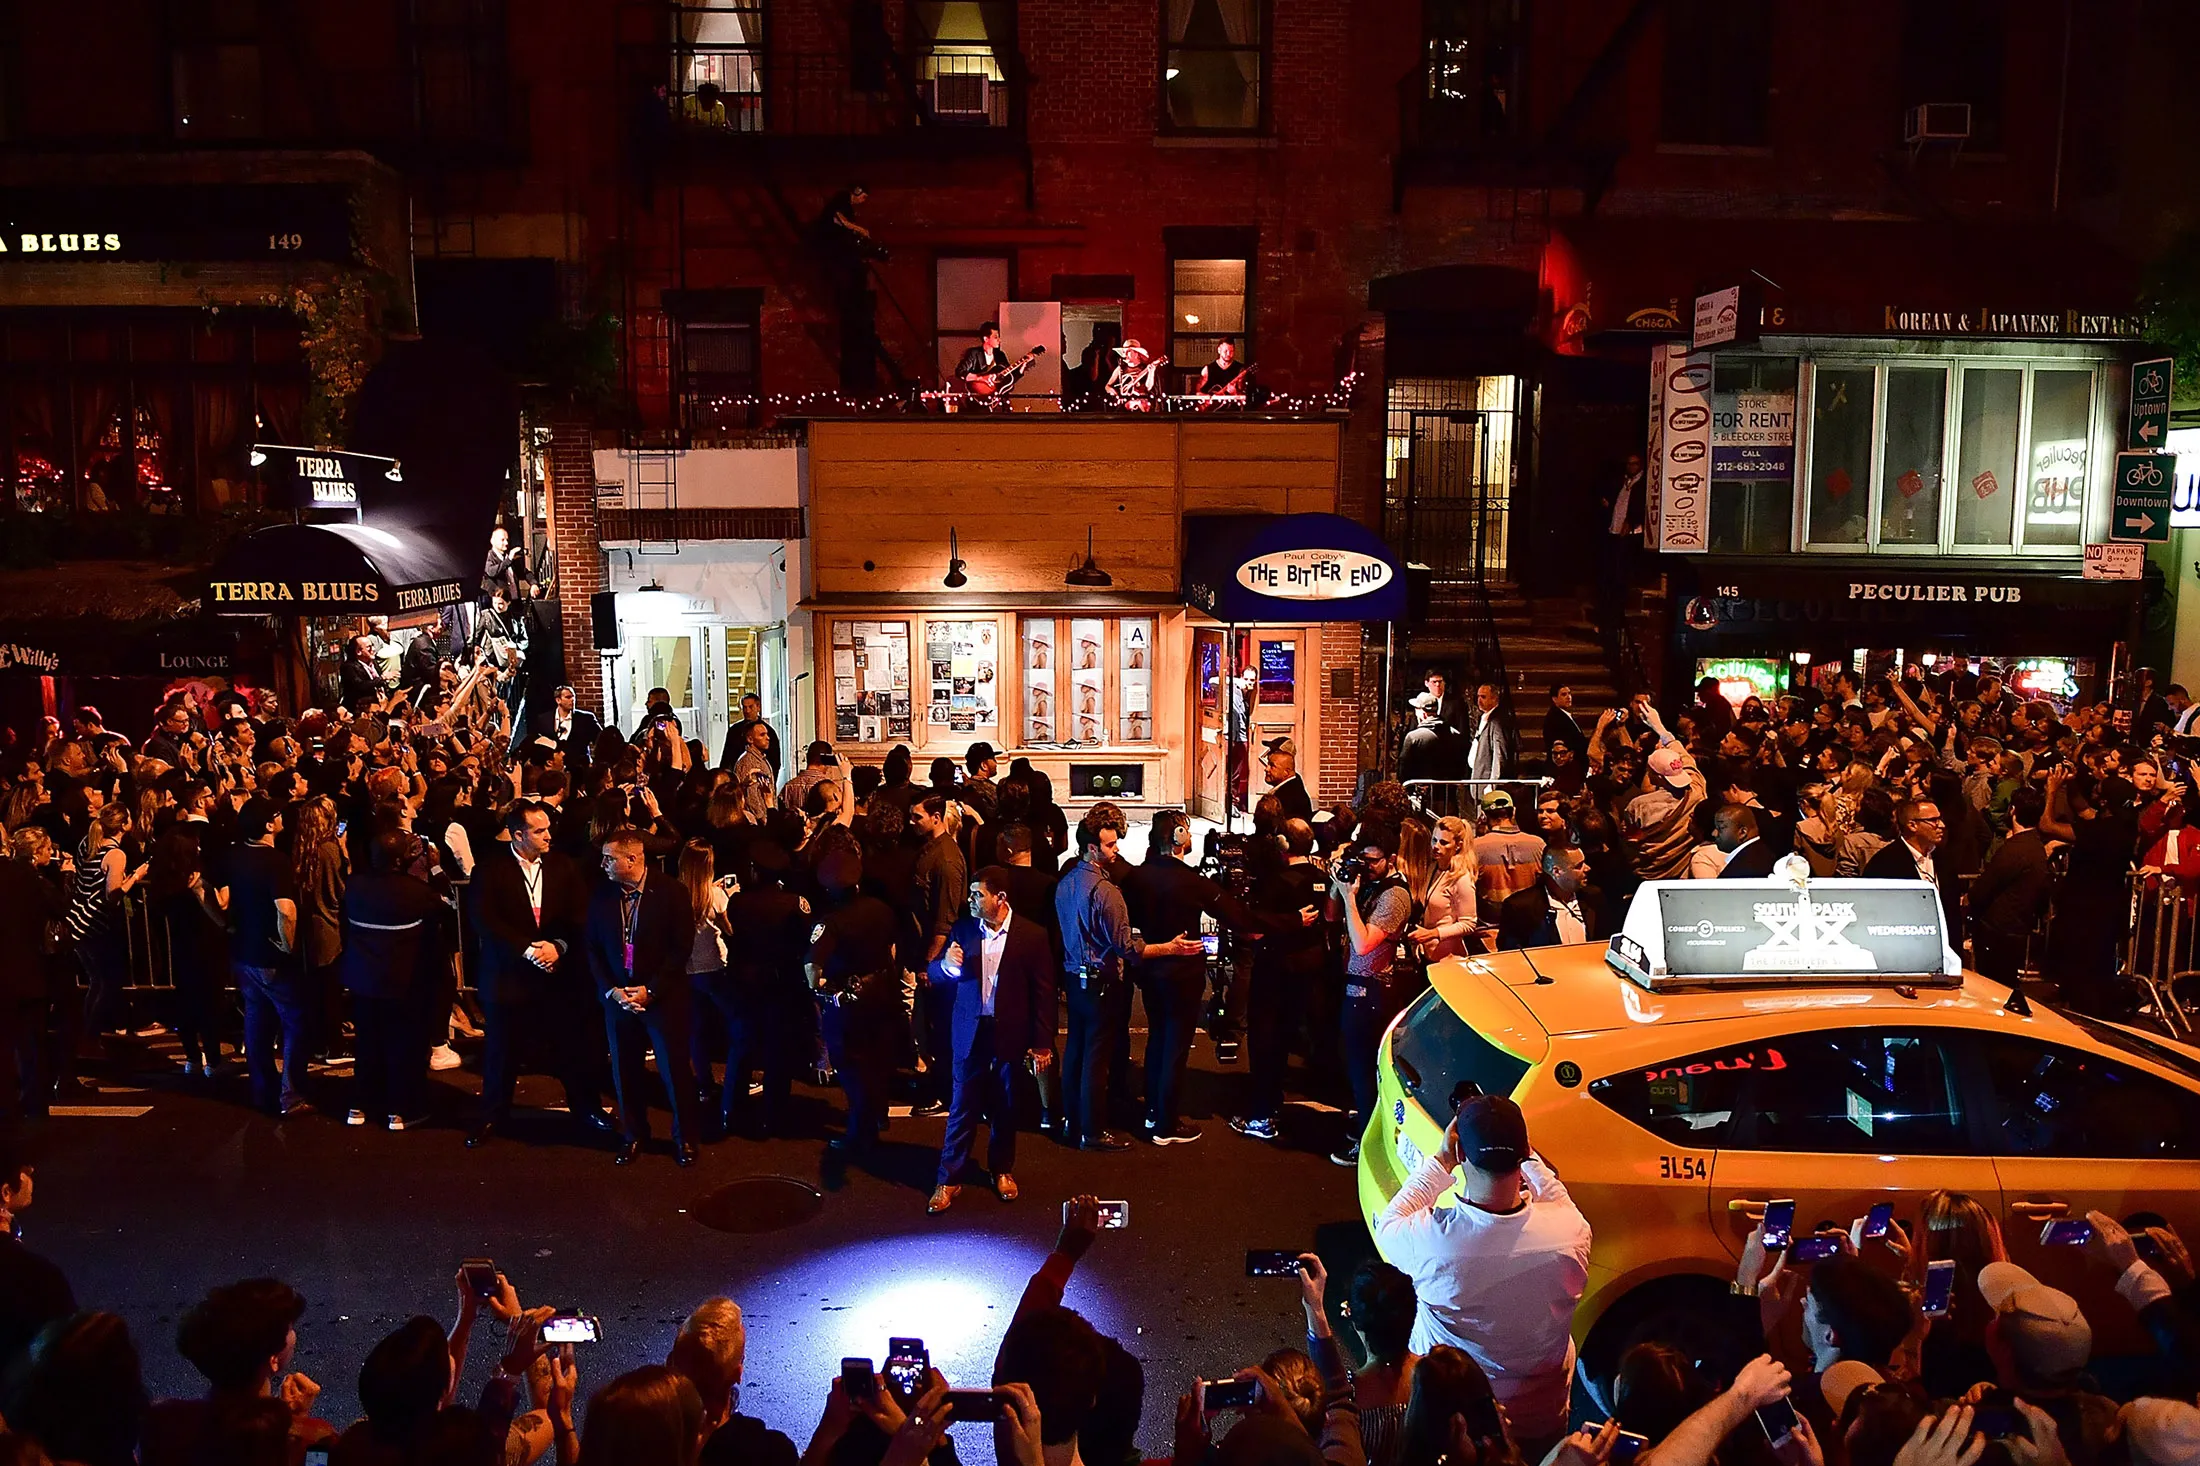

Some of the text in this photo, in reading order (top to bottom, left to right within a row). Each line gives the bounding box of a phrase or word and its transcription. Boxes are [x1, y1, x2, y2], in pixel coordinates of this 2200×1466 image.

[21, 233, 121, 252] BLUES
[269, 233, 302, 250] 149
[1885, 305, 1952, 331] KOREAN
[1958, 313, 1970, 331] &
[1976, 308, 2059, 333] JAPANESE
[1738, 400, 1768, 408] STORE
[2133, 402, 2167, 419] Uptown
[1712, 413, 1743, 428] FOR
[1750, 413, 1791, 428] RENT
[1721, 432, 1765, 441] BLEECKER
[296, 456, 344, 479] TERRA
[312, 481, 357, 502] BLUES
[2116, 496, 2169, 508] Downtown
[1310, 553, 1346, 562] Colby's
[2086, 546, 2102, 559] NO
[1248, 561, 1382, 587] THE BITTER END
[210, 582, 379, 602] TERRA BLUES
[396, 583, 462, 610] TERRA BLUES
[1717, 586, 1739, 597] 145
[1849, 584, 2021, 603] PECULIER PUB
[1131, 627, 1144, 641] A
[1753, 903, 1857, 917] SOUTH PARK
[1867, 925, 1937, 936] WEDNESDAYS
[1659, 1156, 1707, 1180] 3L54
